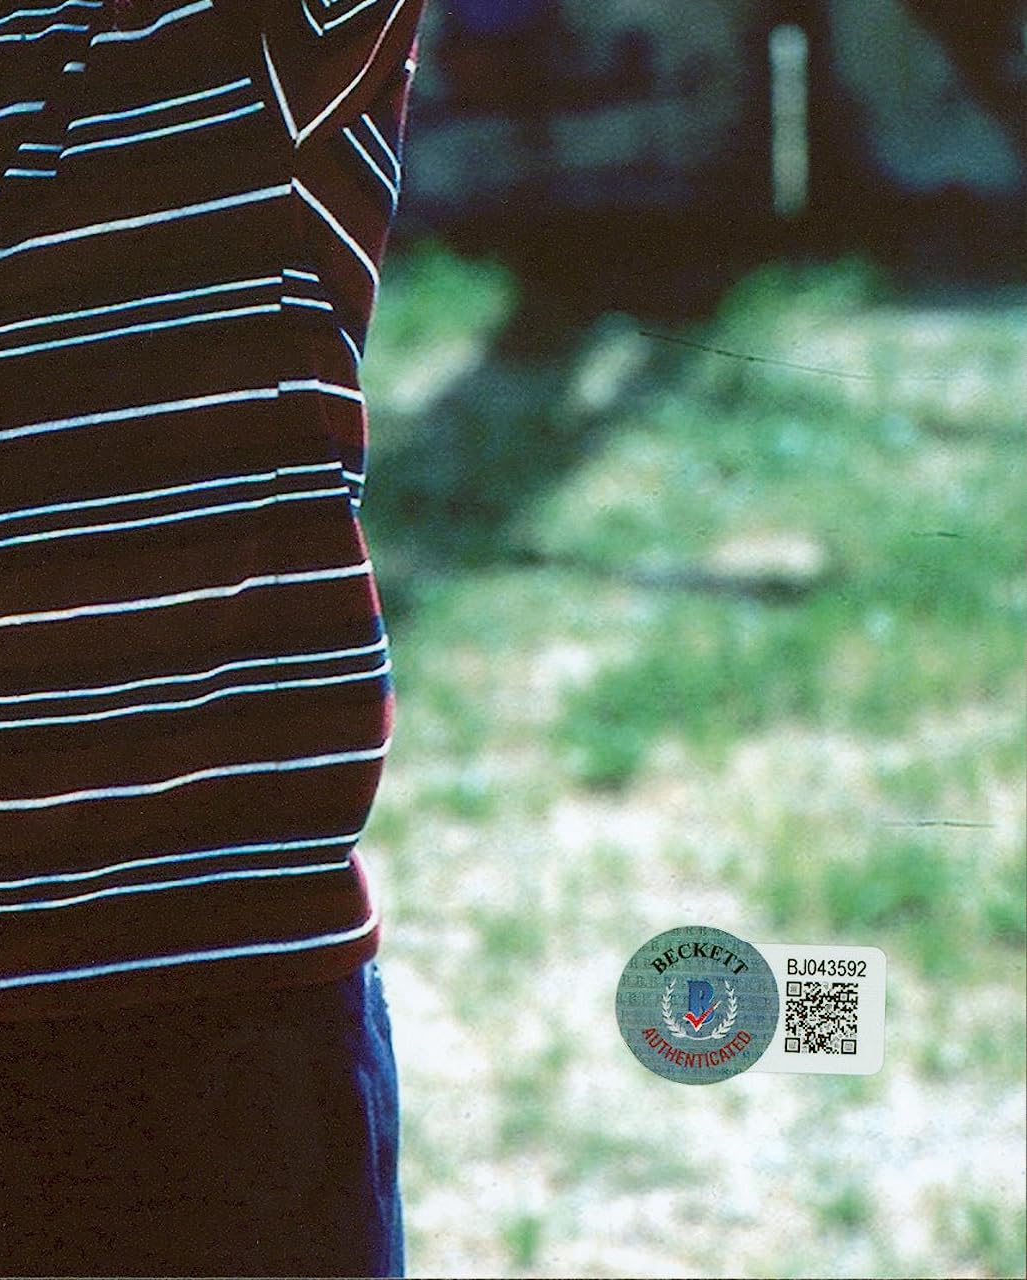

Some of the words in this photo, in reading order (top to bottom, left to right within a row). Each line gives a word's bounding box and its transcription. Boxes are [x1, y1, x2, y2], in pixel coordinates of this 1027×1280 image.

[650, 942, 749, 976] BECKETT
[787, 958, 867, 977] BJ043592
[641, 1026, 753, 1070] AUTHENTICATED
